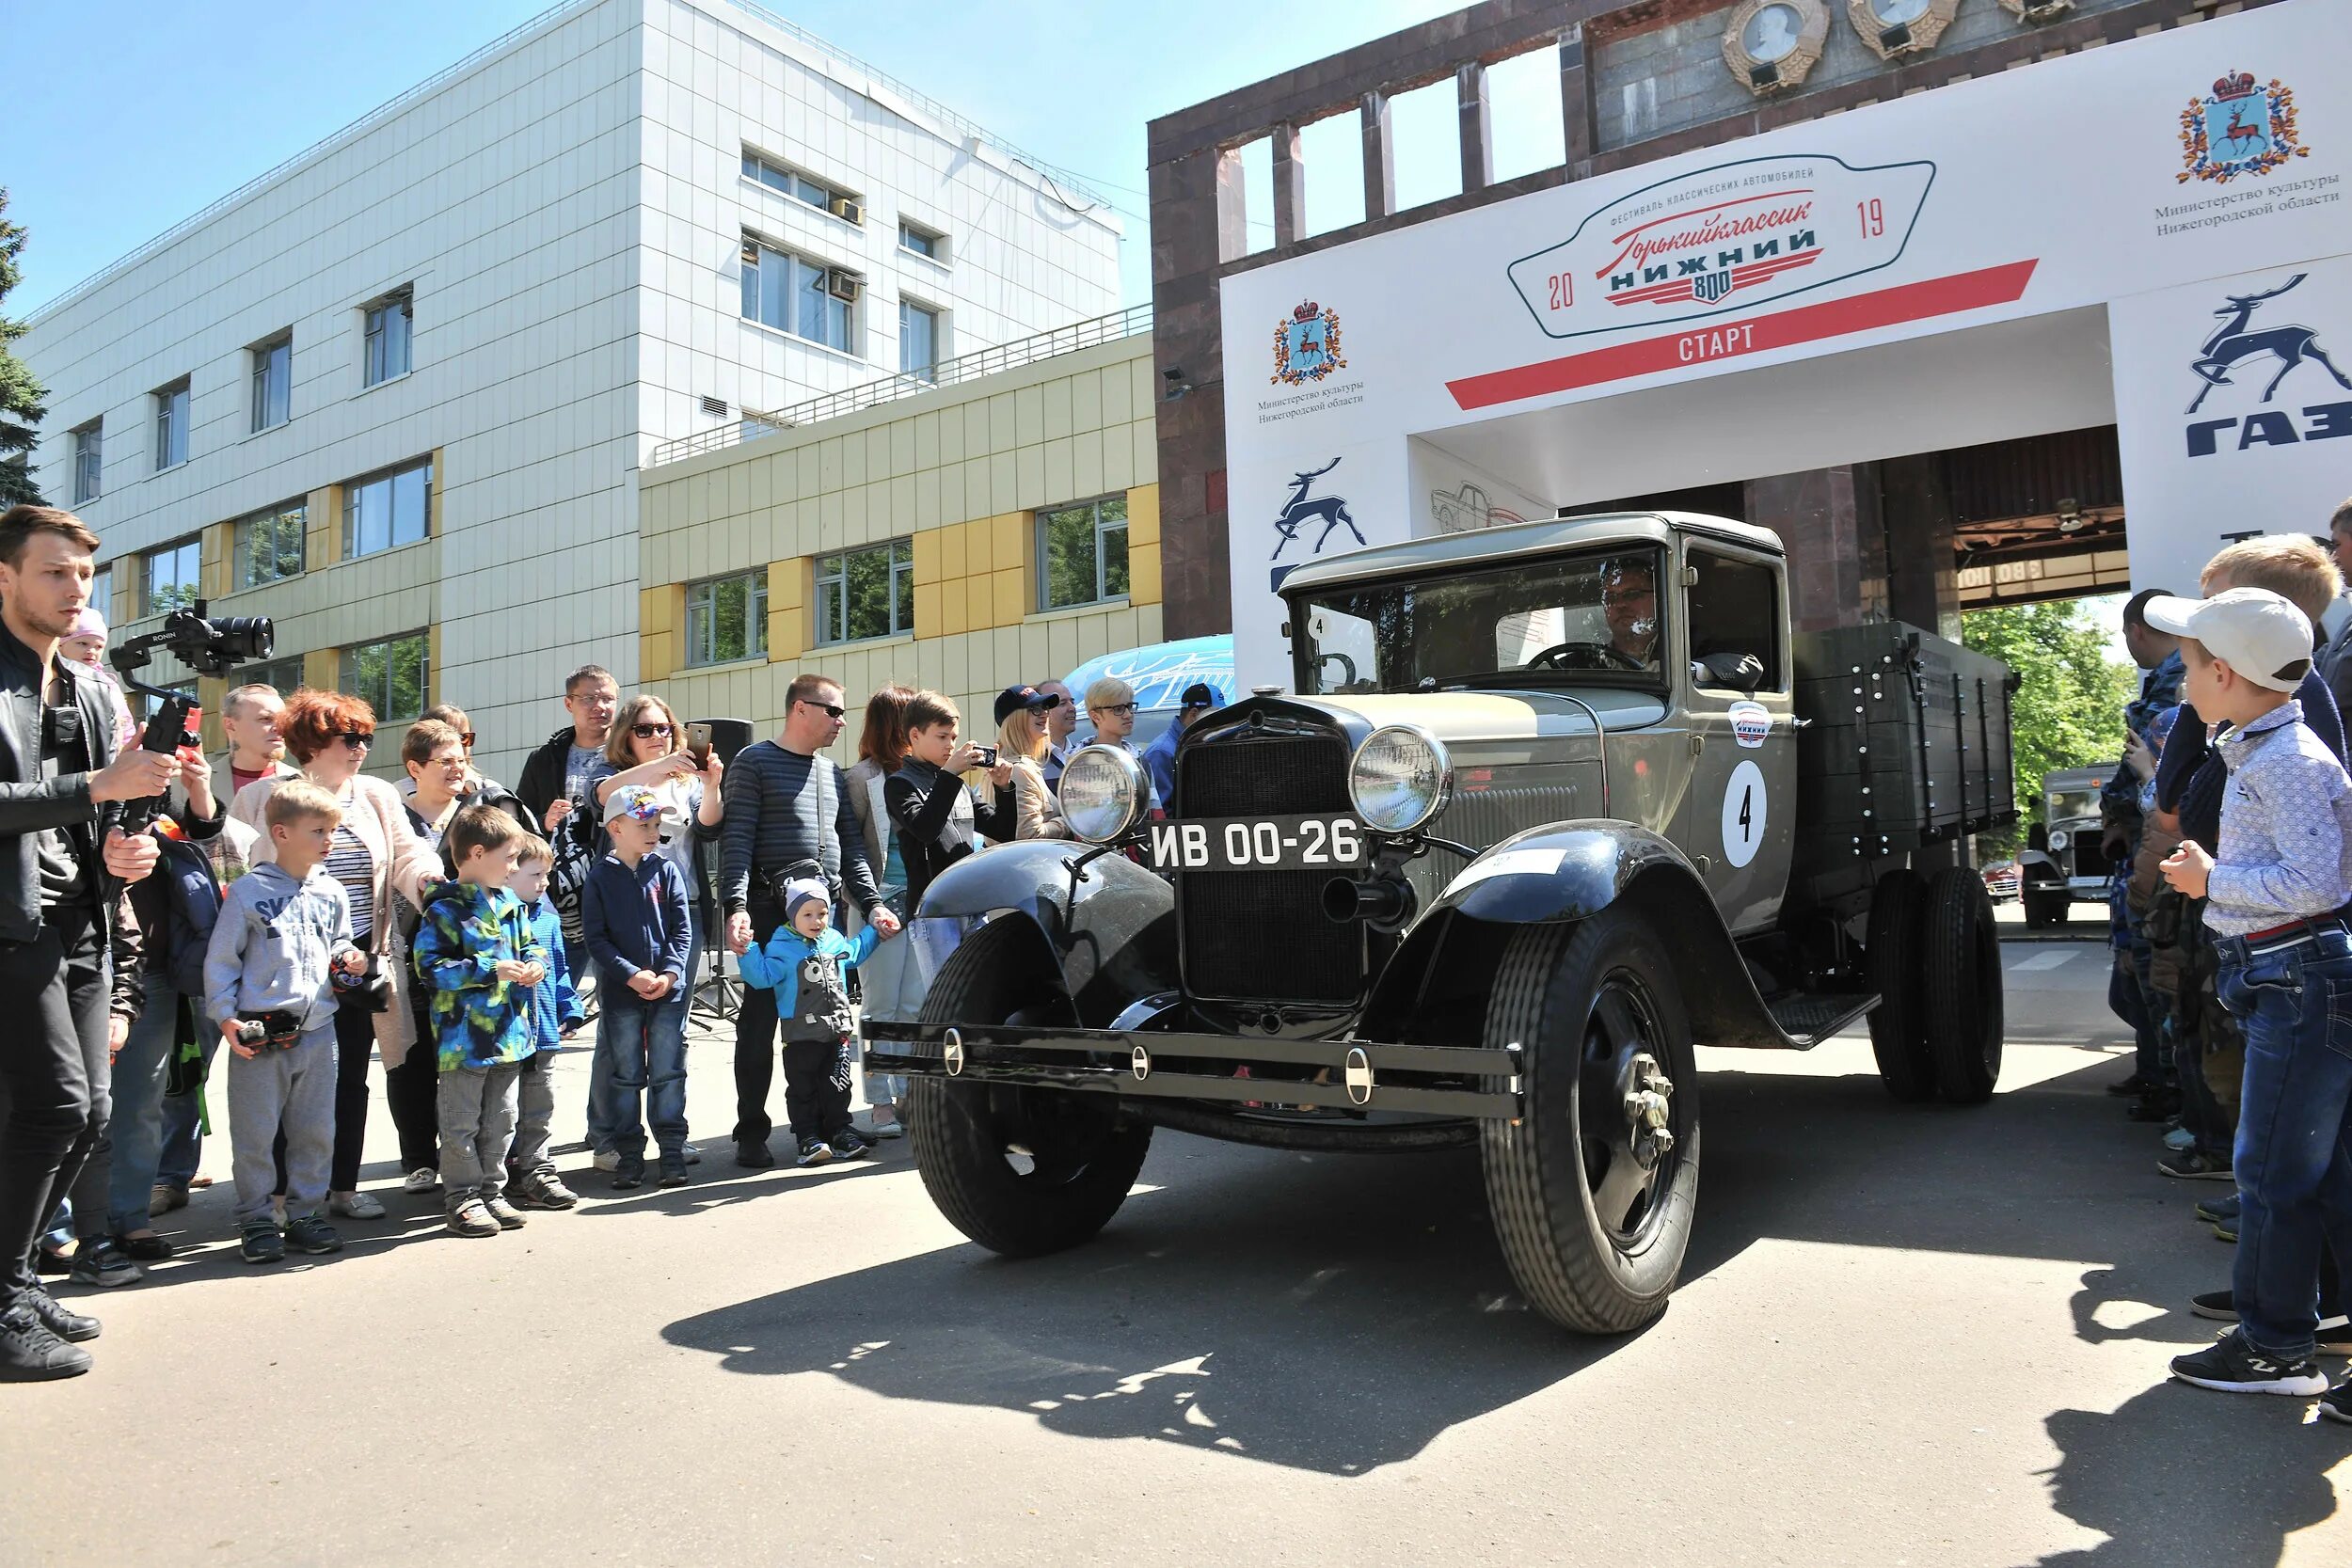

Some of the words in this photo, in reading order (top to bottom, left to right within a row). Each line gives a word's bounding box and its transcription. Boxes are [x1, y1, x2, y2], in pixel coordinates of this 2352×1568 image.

[1611, 199, 1663, 226] ФЕСТИВАЛЬ
[1667, 180, 1739, 206] КЛАССИЧЕСКИХ
[1743, 167, 1814, 187] АВТОМОБИЛЕЙ
[2155, 189, 2263, 219] Министерство
[2267, 174, 2340, 197] культуры
[2157, 203, 2274, 236] Нижегородской
[2279, 192, 2340, 212] области
[1856, 198, 1884, 239] 19
[1612, 229, 1815, 291] НИЖНИЙ
[1549, 273, 1573, 309] 20
[1694, 270, 1730, 301] 800
[1678, 324, 1755, 361] СТАРТ
[1258, 391, 1320, 411] Министерство
[1322, 381, 1364, 397] культуры
[1259, 403, 1326, 423] Нижегородской
[1327, 395, 1364, 409] области
[2186, 401, 2352, 457] ГАЗ
[152, 631, 177, 641] RONIN
[1316, 619, 1323, 633] 4
[1740, 784, 1751, 842] 4
[1151, 824, 1209, 867] ИВ
[1224, 818, 1359, 865] 00-26
